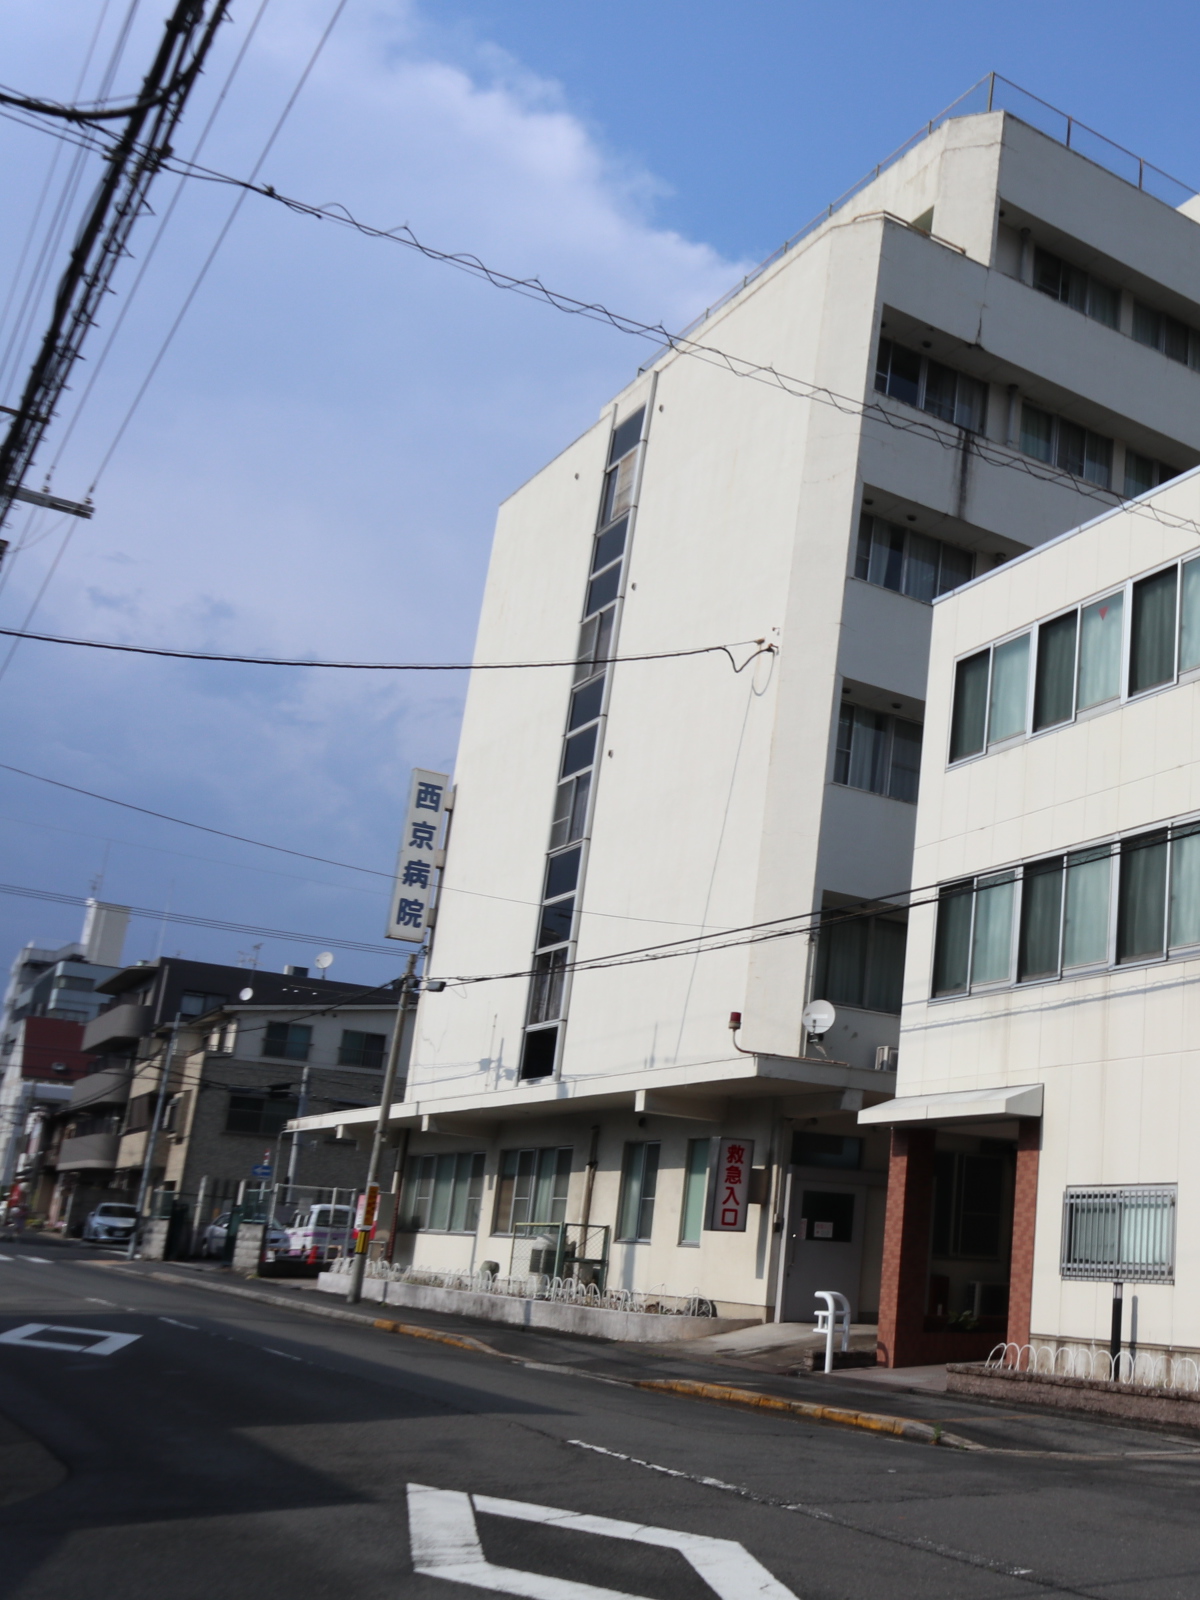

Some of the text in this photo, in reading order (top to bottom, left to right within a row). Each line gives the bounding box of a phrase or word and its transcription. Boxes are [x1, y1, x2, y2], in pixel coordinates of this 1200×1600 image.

[396, 781, 443, 928] 西京病院
[721, 1144, 745, 1226] 救急入口
